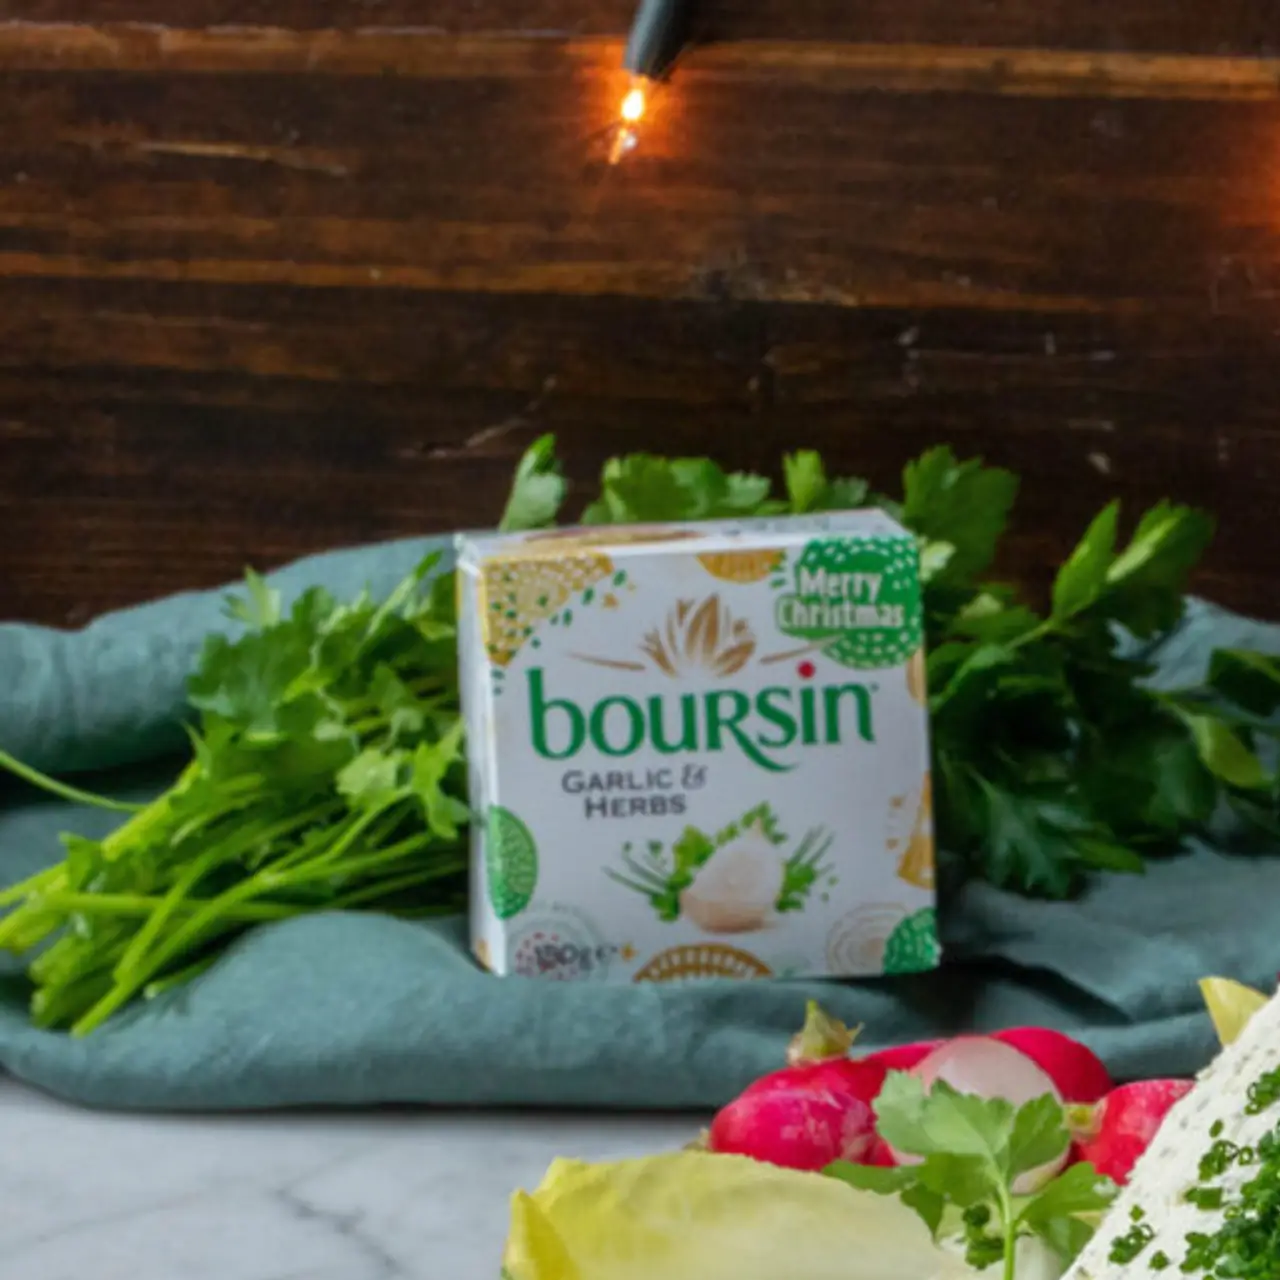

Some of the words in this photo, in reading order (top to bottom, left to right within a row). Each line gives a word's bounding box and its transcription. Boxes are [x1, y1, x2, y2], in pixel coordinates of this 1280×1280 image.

[800, 566, 882, 605] Merry
[777, 597, 905, 629] Christmas
[561, 768, 673, 794] GARLIC
[680, 763, 708, 791] &
[584, 793, 688, 820] HERBS
